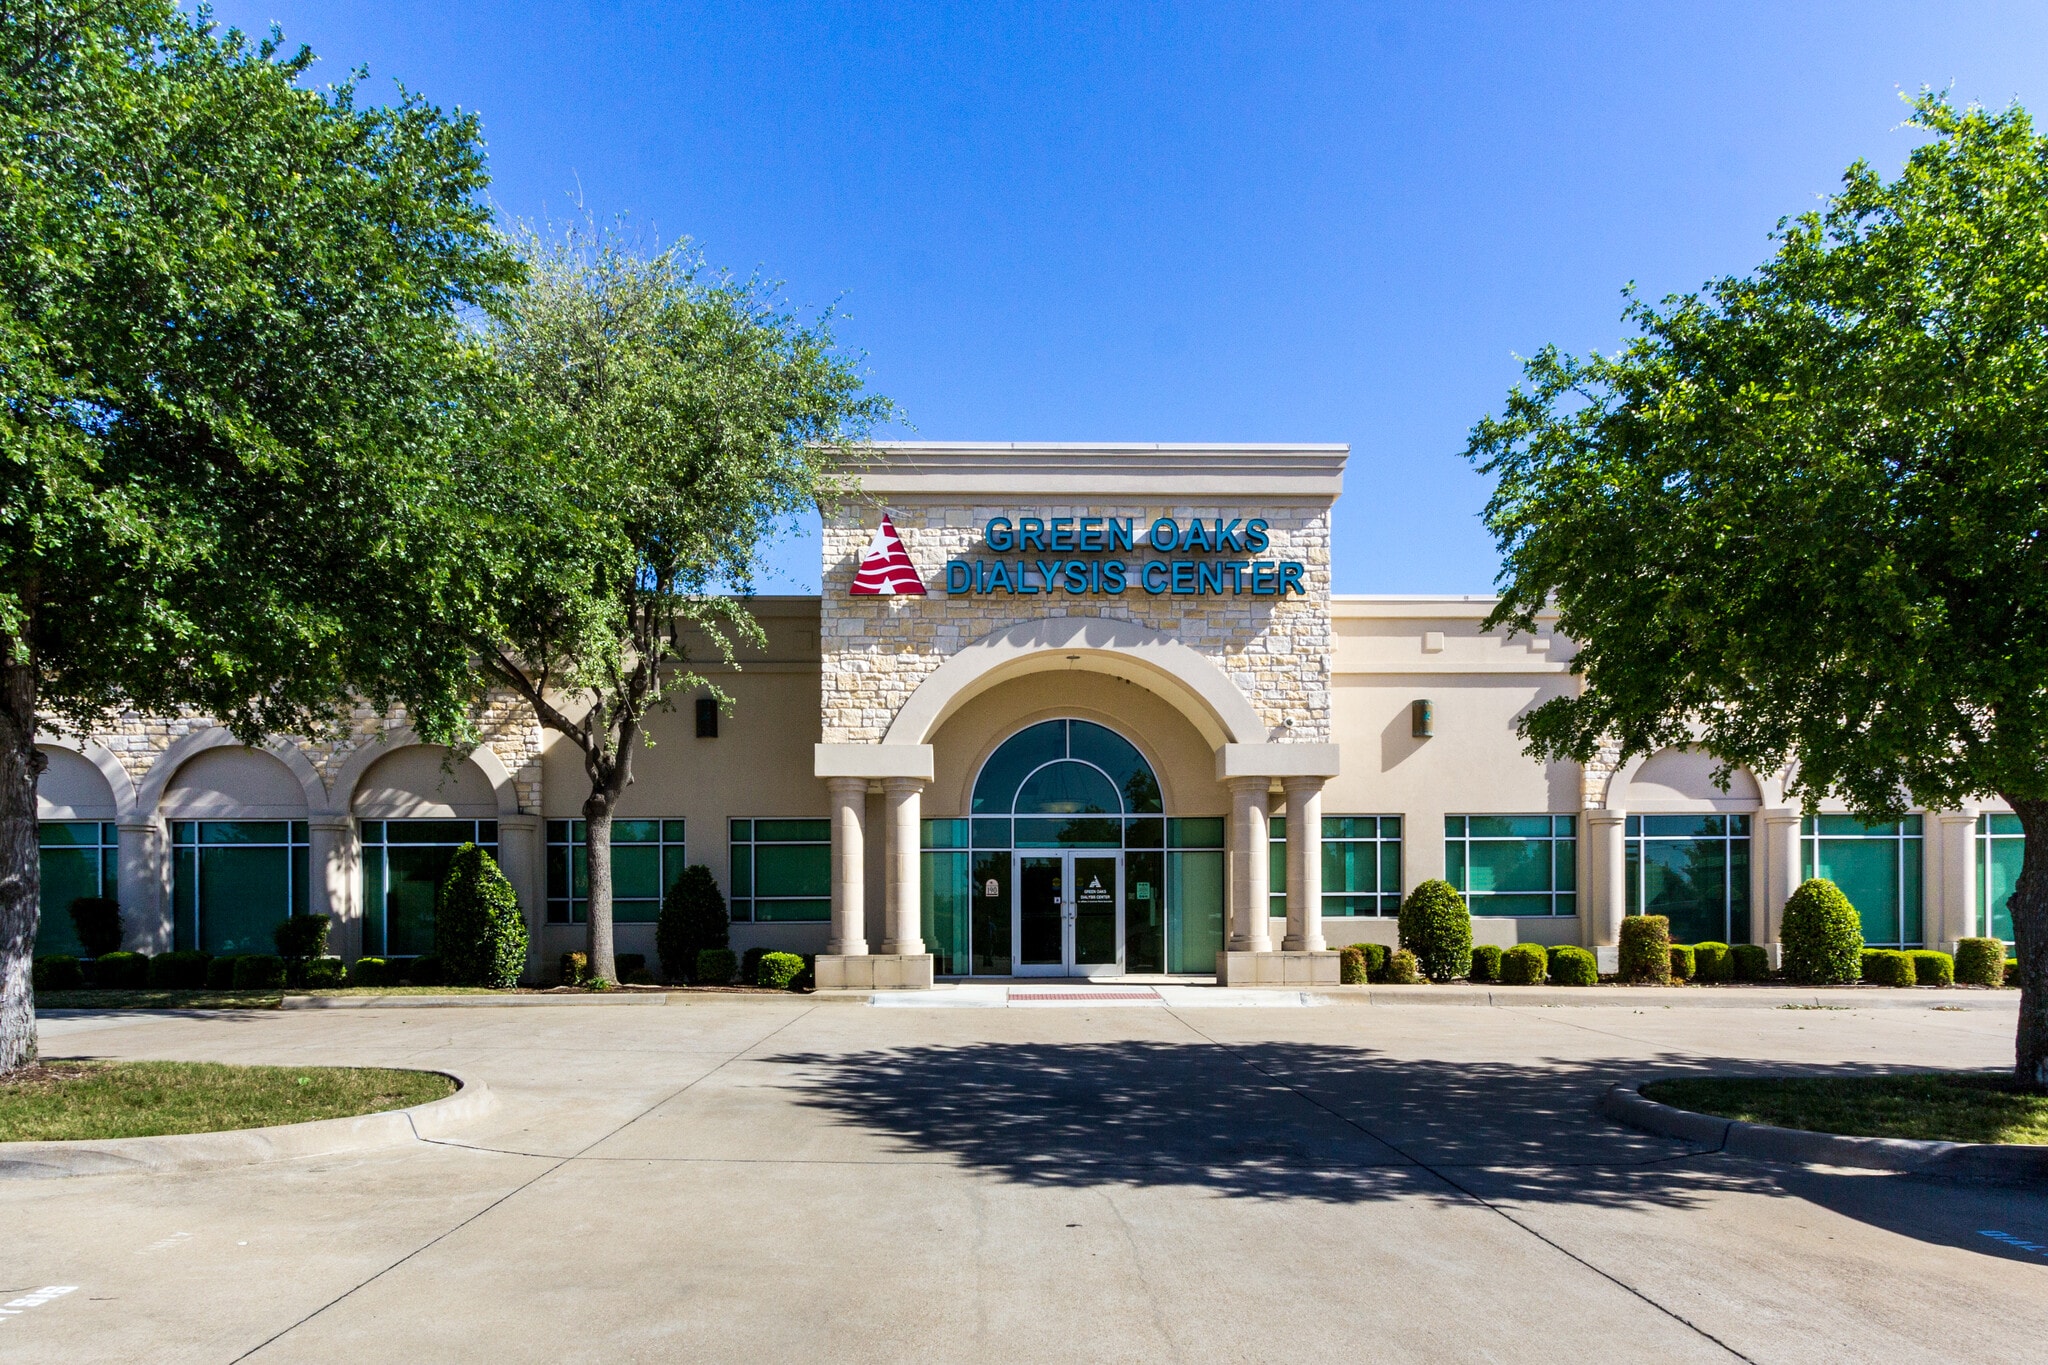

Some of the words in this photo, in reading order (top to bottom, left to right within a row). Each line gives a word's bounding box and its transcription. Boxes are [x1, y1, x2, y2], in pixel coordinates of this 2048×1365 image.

[985, 516, 1134, 552] GREEN
[1150, 517, 1269, 553] OAKS
[946, 560, 1128, 595] DIALYSIS
[1141, 560, 1306, 595] CENTER
